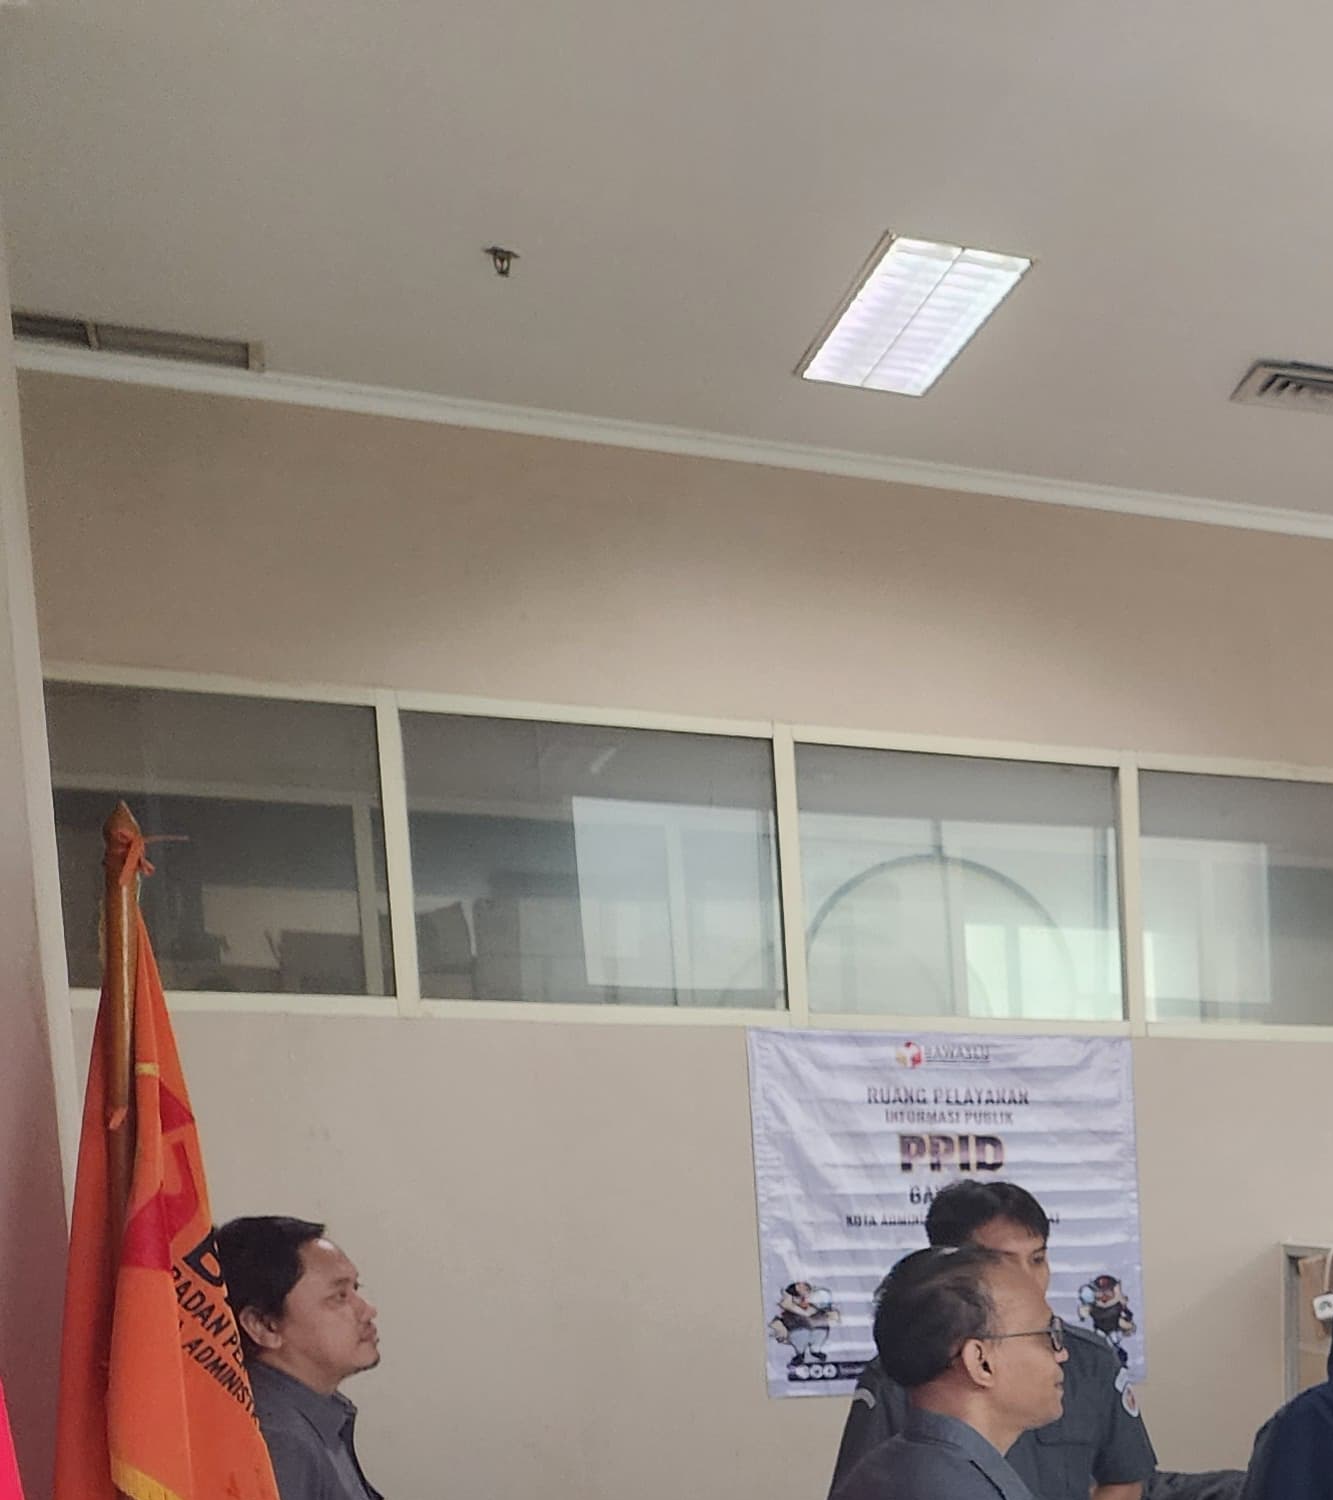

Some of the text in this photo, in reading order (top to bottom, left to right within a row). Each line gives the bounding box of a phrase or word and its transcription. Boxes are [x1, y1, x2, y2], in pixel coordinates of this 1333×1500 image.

[867, 1087, 1029, 1105] RUANG PELAYANAN
[885, 1109, 1014, 1125] INFORMASI PUBLIK
[900, 1134, 1005, 1171] PPID
[222, 1329, 248, 1367] PE
[182, 1338, 254, 1413] ADMINIST
